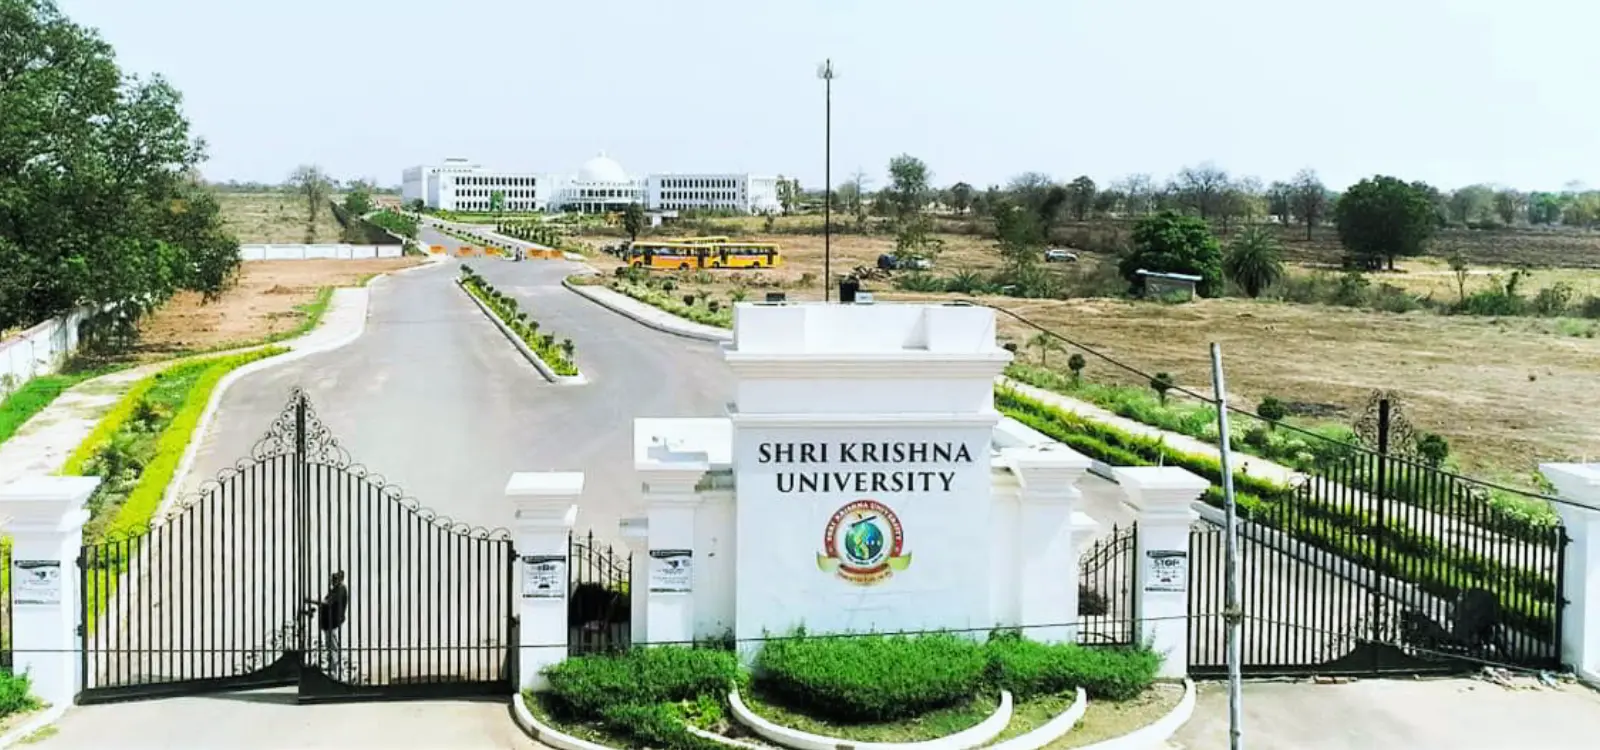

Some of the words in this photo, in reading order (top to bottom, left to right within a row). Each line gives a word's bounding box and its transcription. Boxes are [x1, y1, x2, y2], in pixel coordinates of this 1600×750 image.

[758, 442, 828, 463] SHRI
[840, 442, 973, 463] KRISHNA
[776, 471, 955, 493] UNIVERSITY
